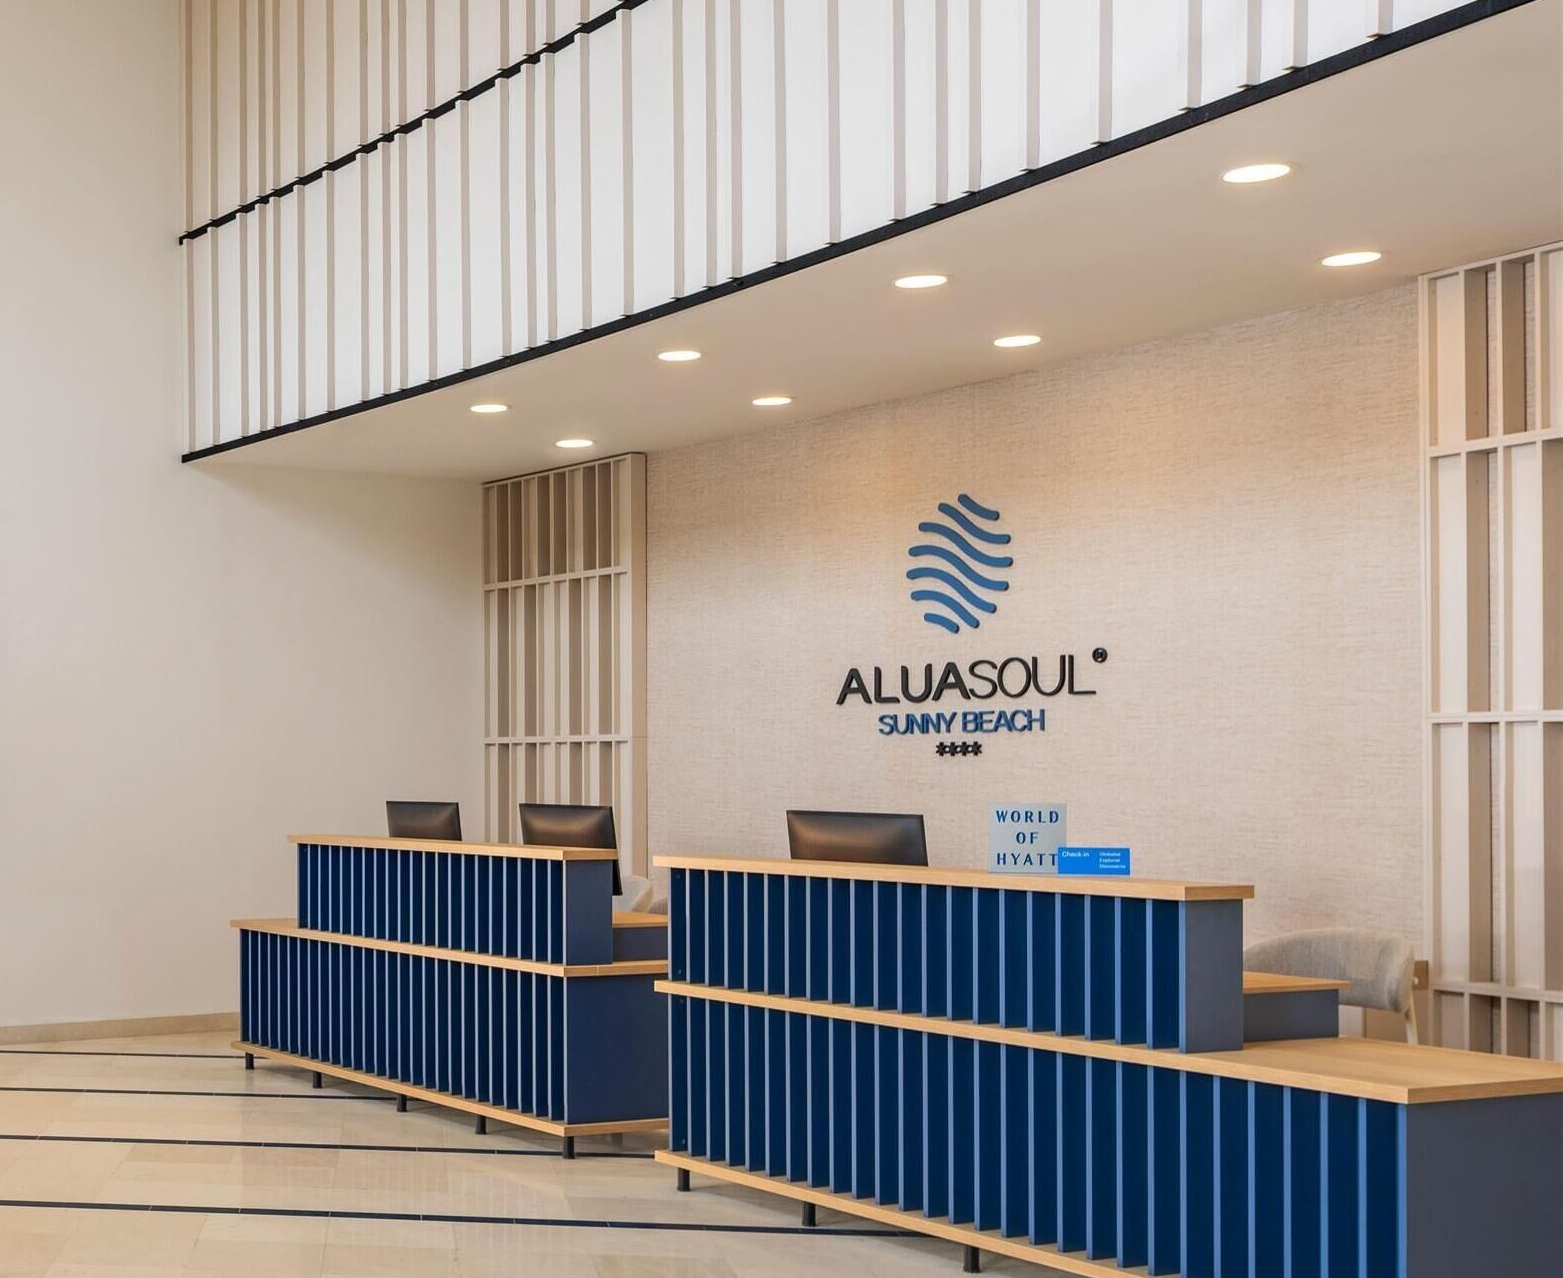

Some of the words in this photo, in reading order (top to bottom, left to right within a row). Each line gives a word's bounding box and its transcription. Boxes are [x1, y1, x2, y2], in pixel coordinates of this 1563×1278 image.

[878, 711, 957, 735] SUNNY
[961, 709, 1046, 733] BEACH
[996, 810, 1059, 824] WORLD
[1016, 831, 1039, 844] OF
[996, 853, 1058, 866] HYATT
